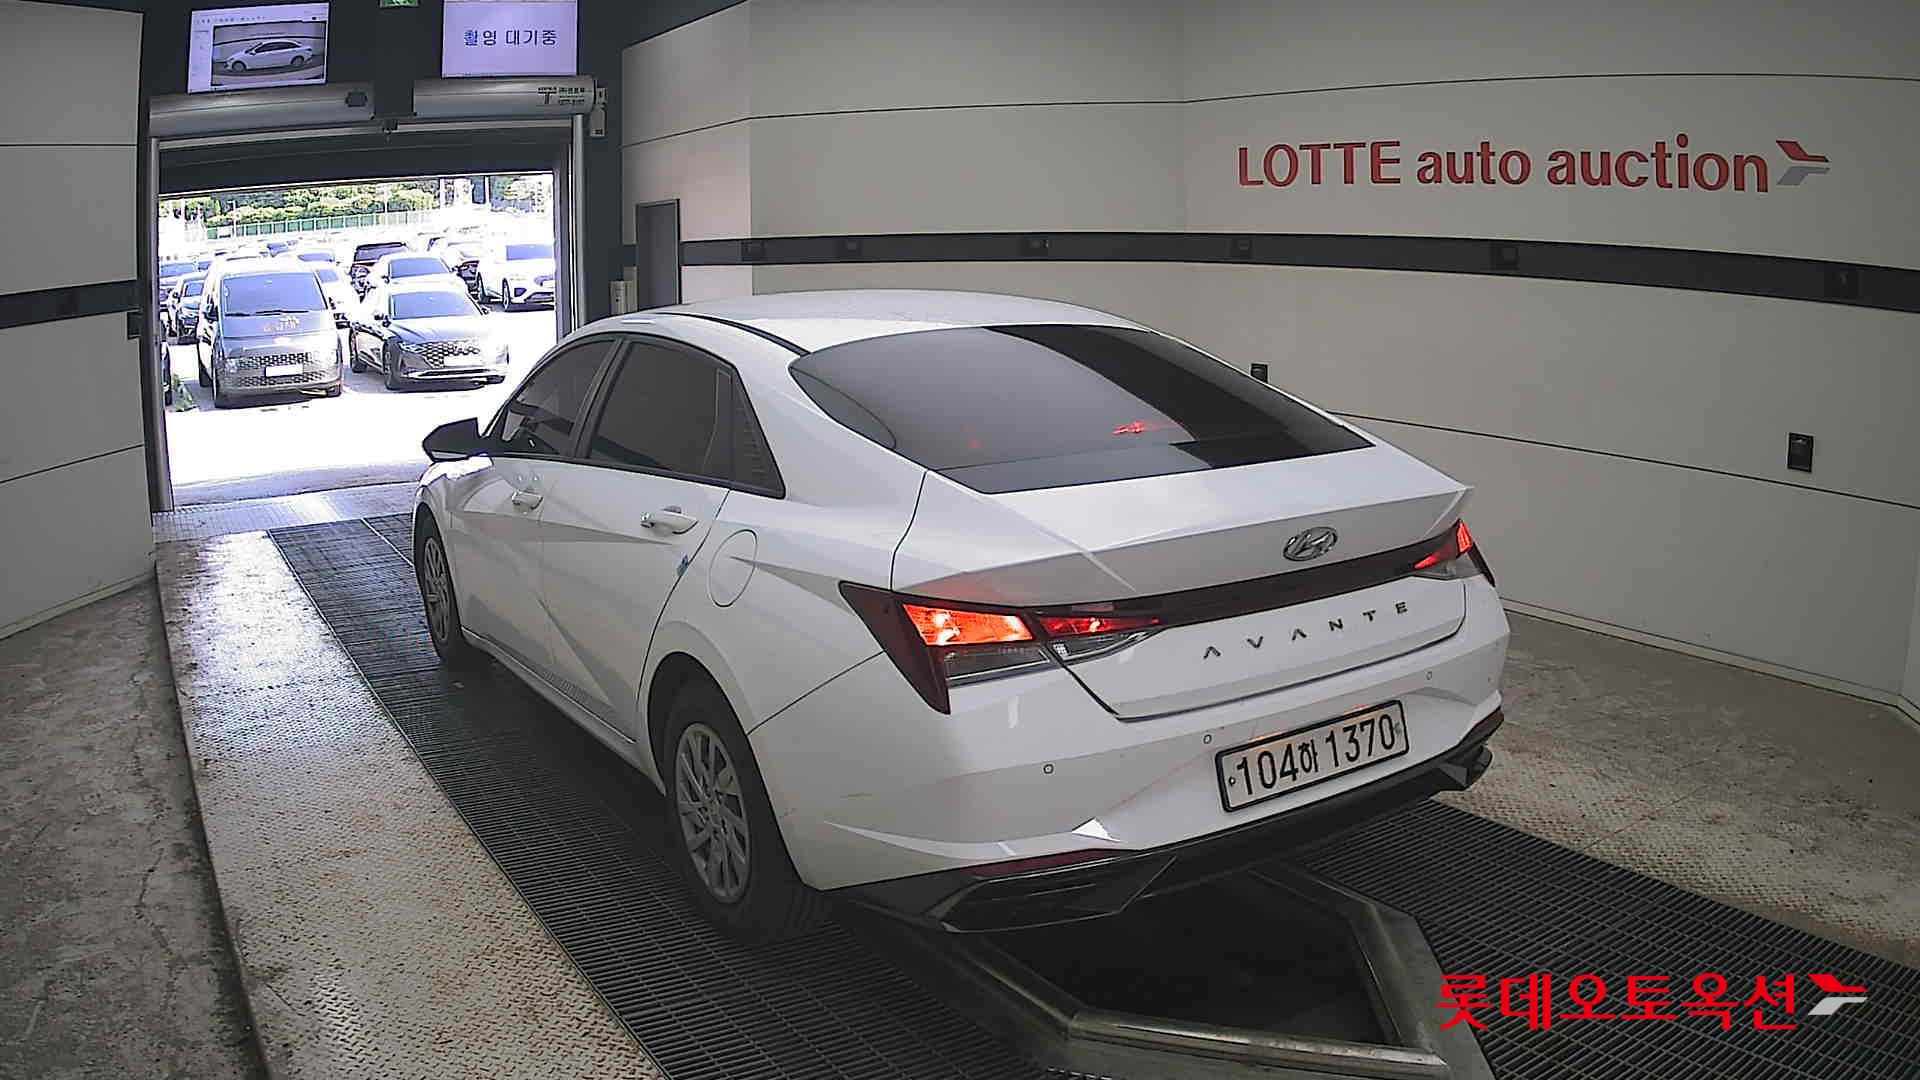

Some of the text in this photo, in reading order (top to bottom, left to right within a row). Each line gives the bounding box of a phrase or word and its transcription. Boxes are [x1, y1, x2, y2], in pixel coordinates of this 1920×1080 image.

[505, 29, 557, 46] 대기중
[1238, 133, 1770, 193] LOTTE auto auction
[1203, 601, 1408, 660] AVANTE
[1236, 713, 1396, 795] 104하 1370
